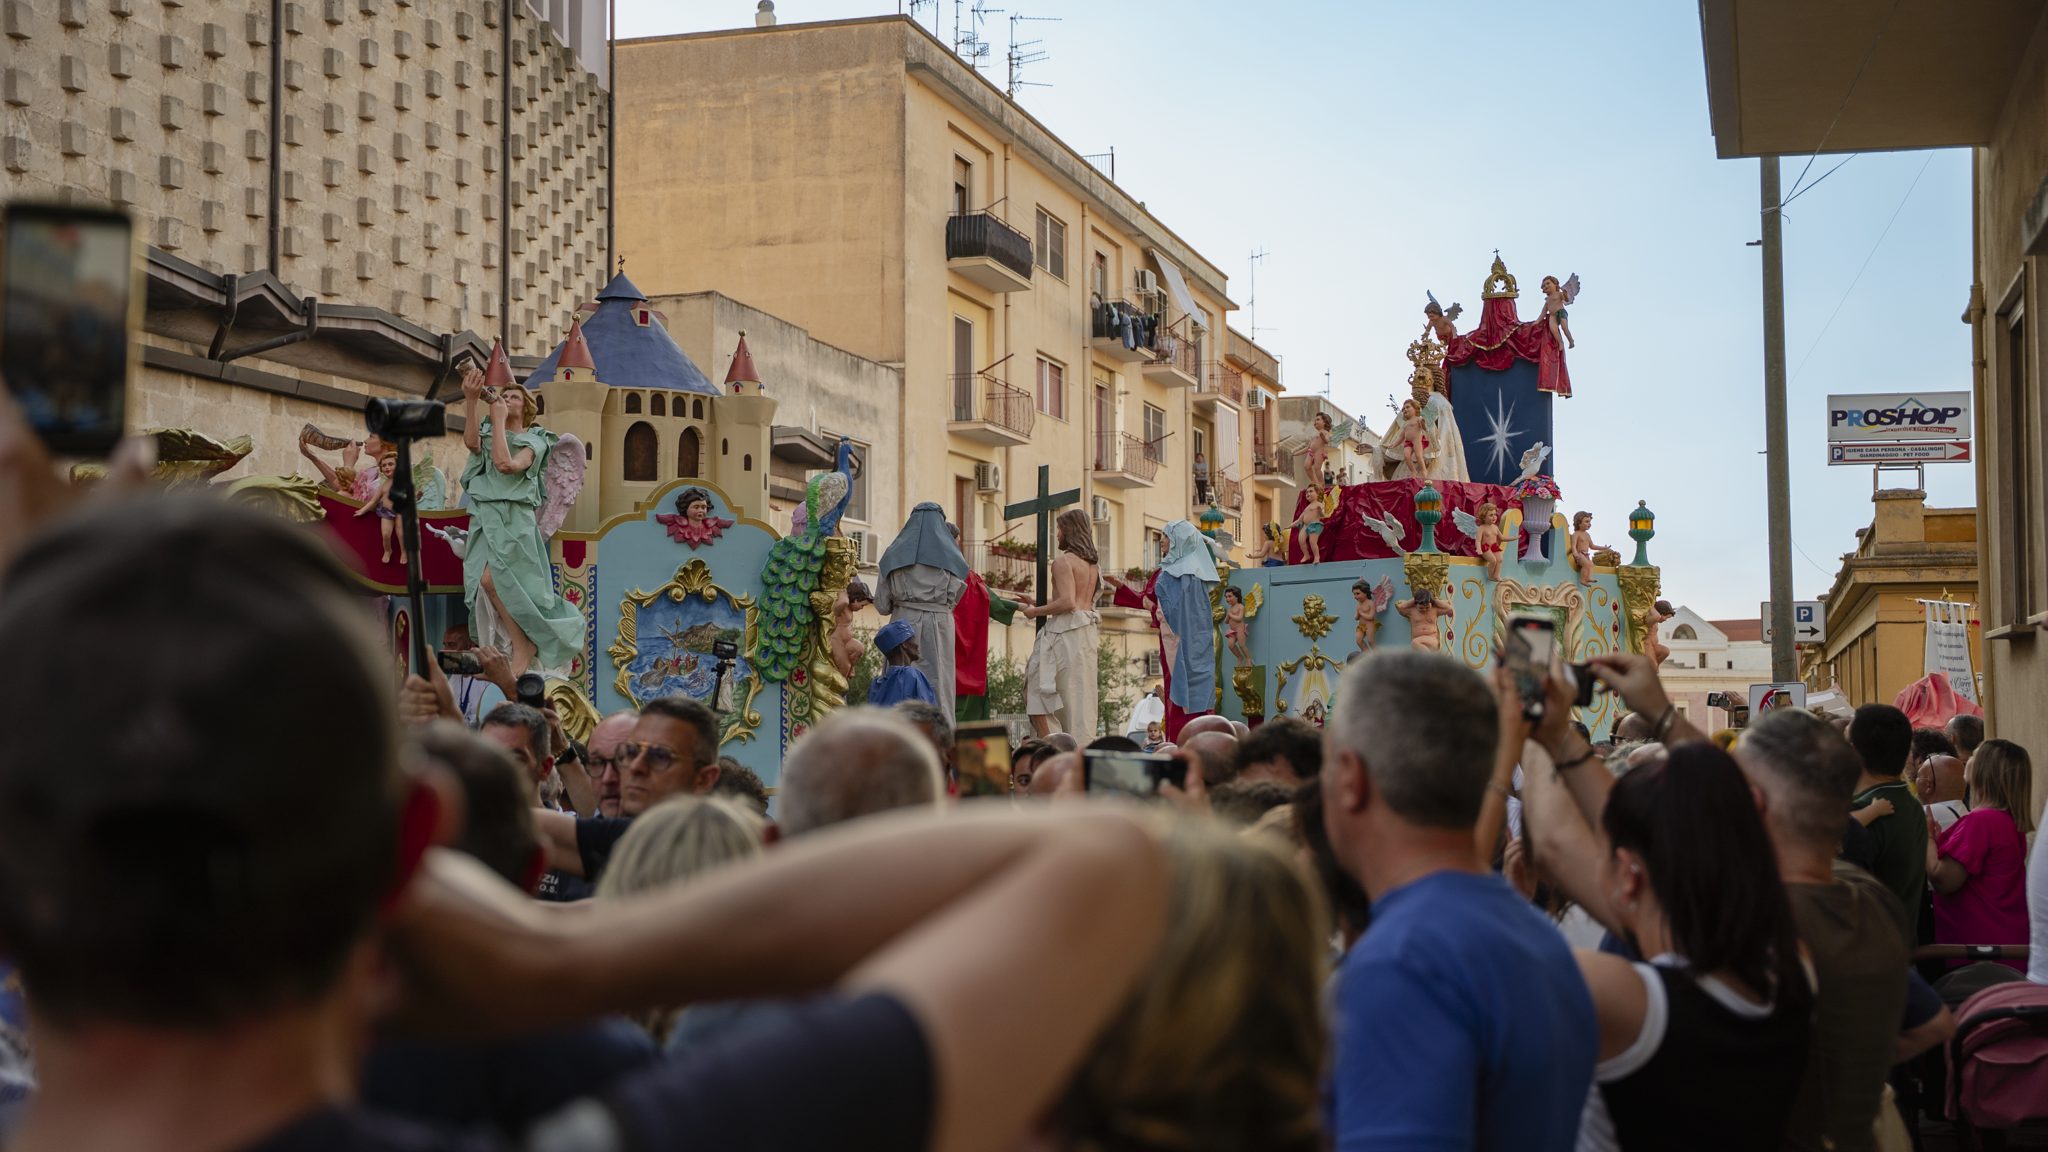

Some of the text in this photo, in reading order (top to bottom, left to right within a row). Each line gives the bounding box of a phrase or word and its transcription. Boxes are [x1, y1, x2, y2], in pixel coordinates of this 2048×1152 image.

[1831, 407, 1962, 427] PROSHOP
[1833, 447, 1842, 460] P
[1800, 609, 1809, 620] P
